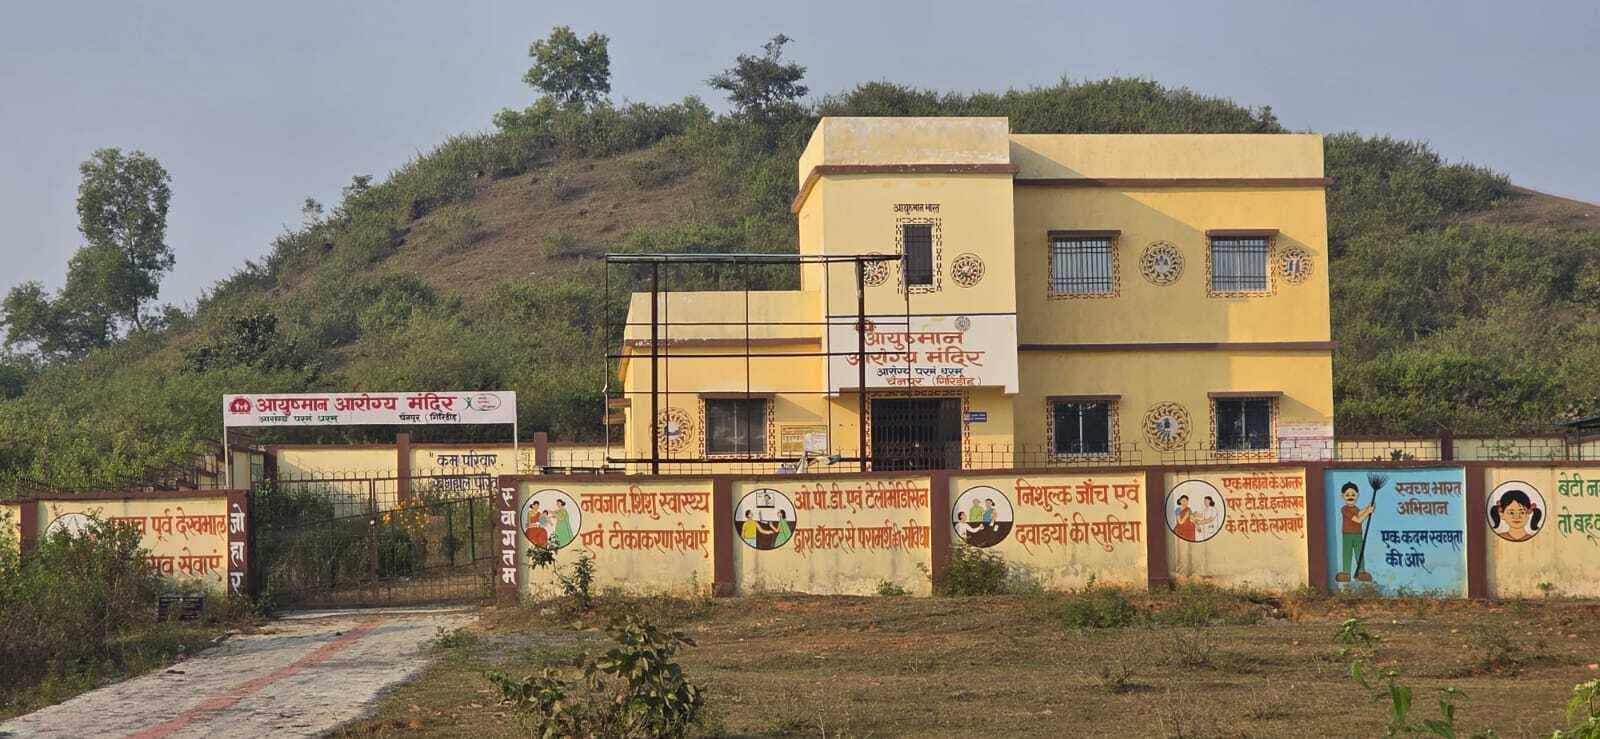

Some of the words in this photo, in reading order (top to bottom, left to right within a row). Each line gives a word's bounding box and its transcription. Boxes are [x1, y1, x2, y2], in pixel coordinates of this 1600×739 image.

[865, 331, 964, 350] आयुष्मान
[926, 345, 985, 367] मंदिर
[256, 398, 329, 416] आयुष्मान
[335, 393, 398, 411] आरोग्य
[406, 393, 458, 411] मंदिर
[1015, 478, 1072, 512] निशुल्क
[1112, 479, 1140, 510] एवं
[1430, 482, 1462, 495] भारत
[1558, 472, 1584, 497] बेटी
[1586, 479, 1600, 497] न
[629, 484, 660, 520] शिशु
[845, 486, 863, 514] एवं
[1396, 498, 1449, 515] अभियान
[151, 508, 173, 543] पूर्व
[176, 507, 227, 542] देखभाल
[1069, 512, 1091, 545] की
[1090, 514, 1142, 552] सुविधा
[1557, 506, 1572, 538] तो
[580, 523, 604, 559] एवं
[608, 521, 675, 553] टीकाकरण
[1380, 531, 1401, 549] एक
[1400, 531, 1428, 545] कदम
[179, 547, 223, 582] सेवाएं
[1385, 548, 1403, 567] की
[1405, 547, 1433, 575] ओर
